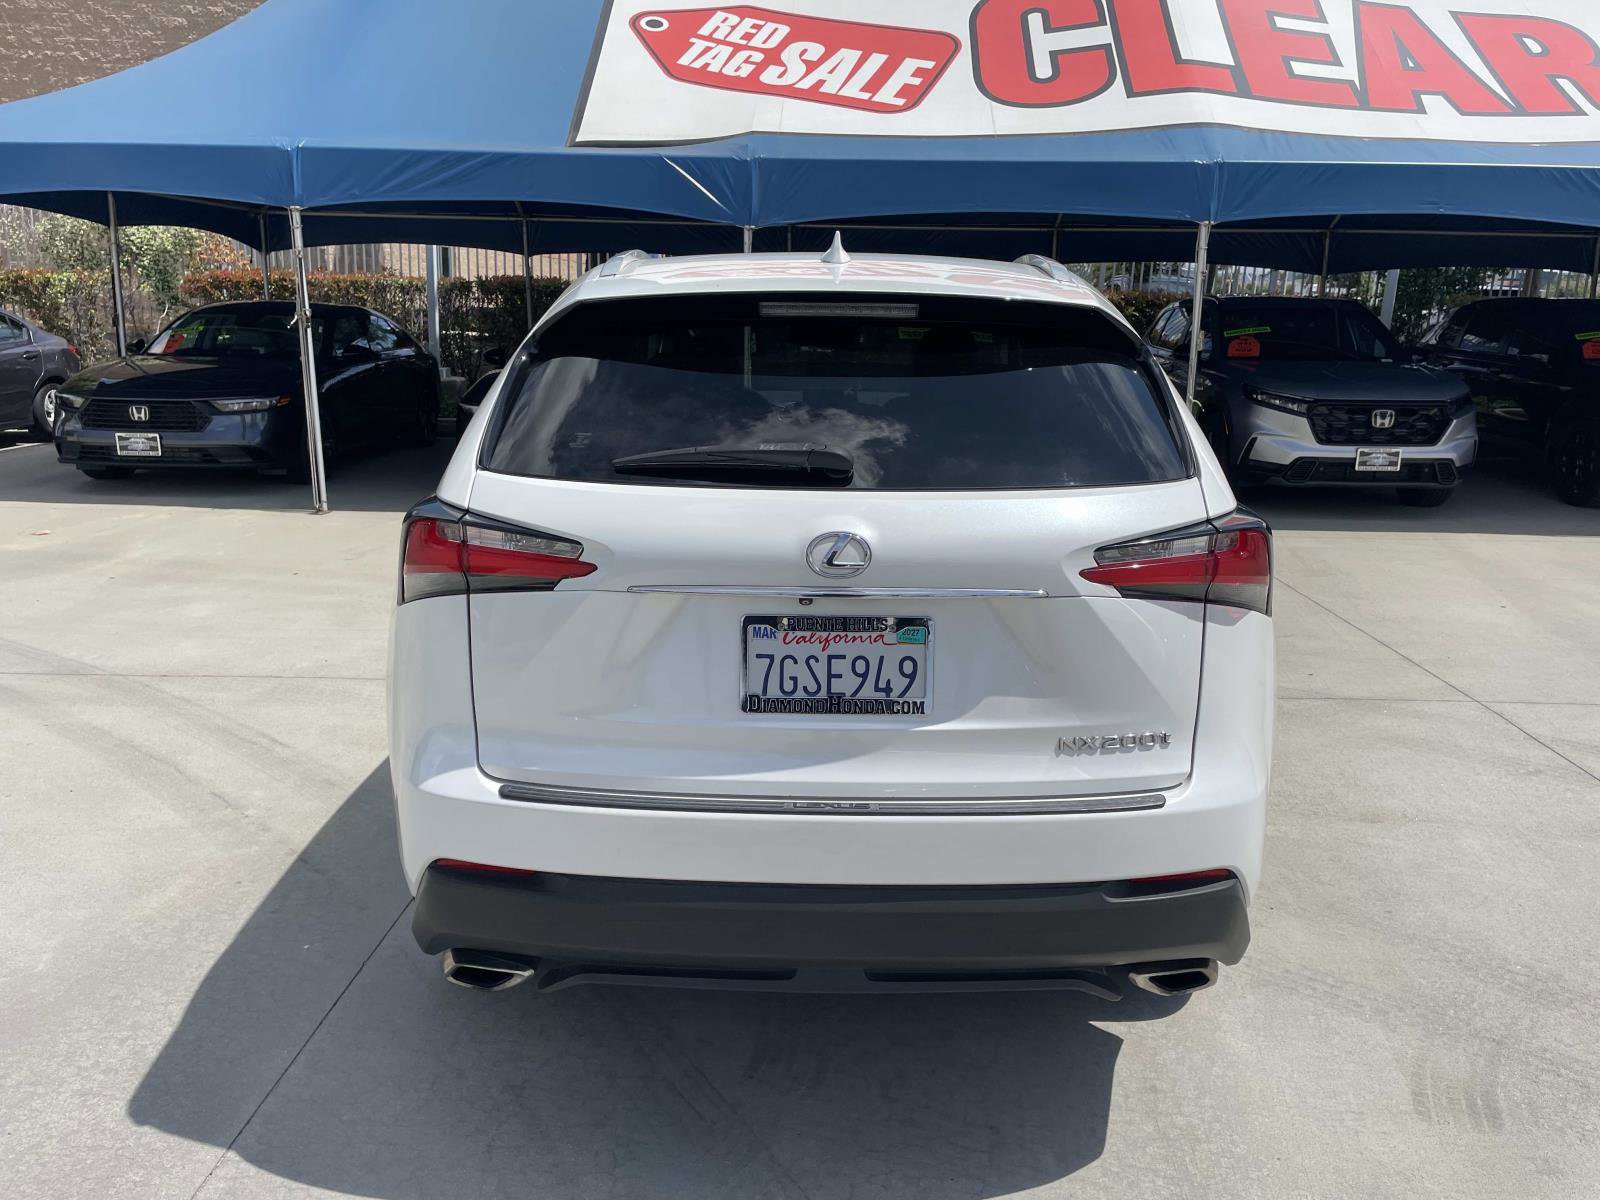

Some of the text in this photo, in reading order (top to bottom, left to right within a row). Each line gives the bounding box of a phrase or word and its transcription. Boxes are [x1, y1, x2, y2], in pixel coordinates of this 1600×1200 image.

[697, 10, 791, 50] RED
[676, 37, 937, 106] TAG SALE
[968, 0, 1600, 116] CLEAR
[752, 626, 777, 640] MAR
[787, 618, 889, 632] PUENTE HILLS
[902, 628, 920, 638] 2027
[782, 631, 898, 651] California
[755, 653, 919, 698] 7GSE949
